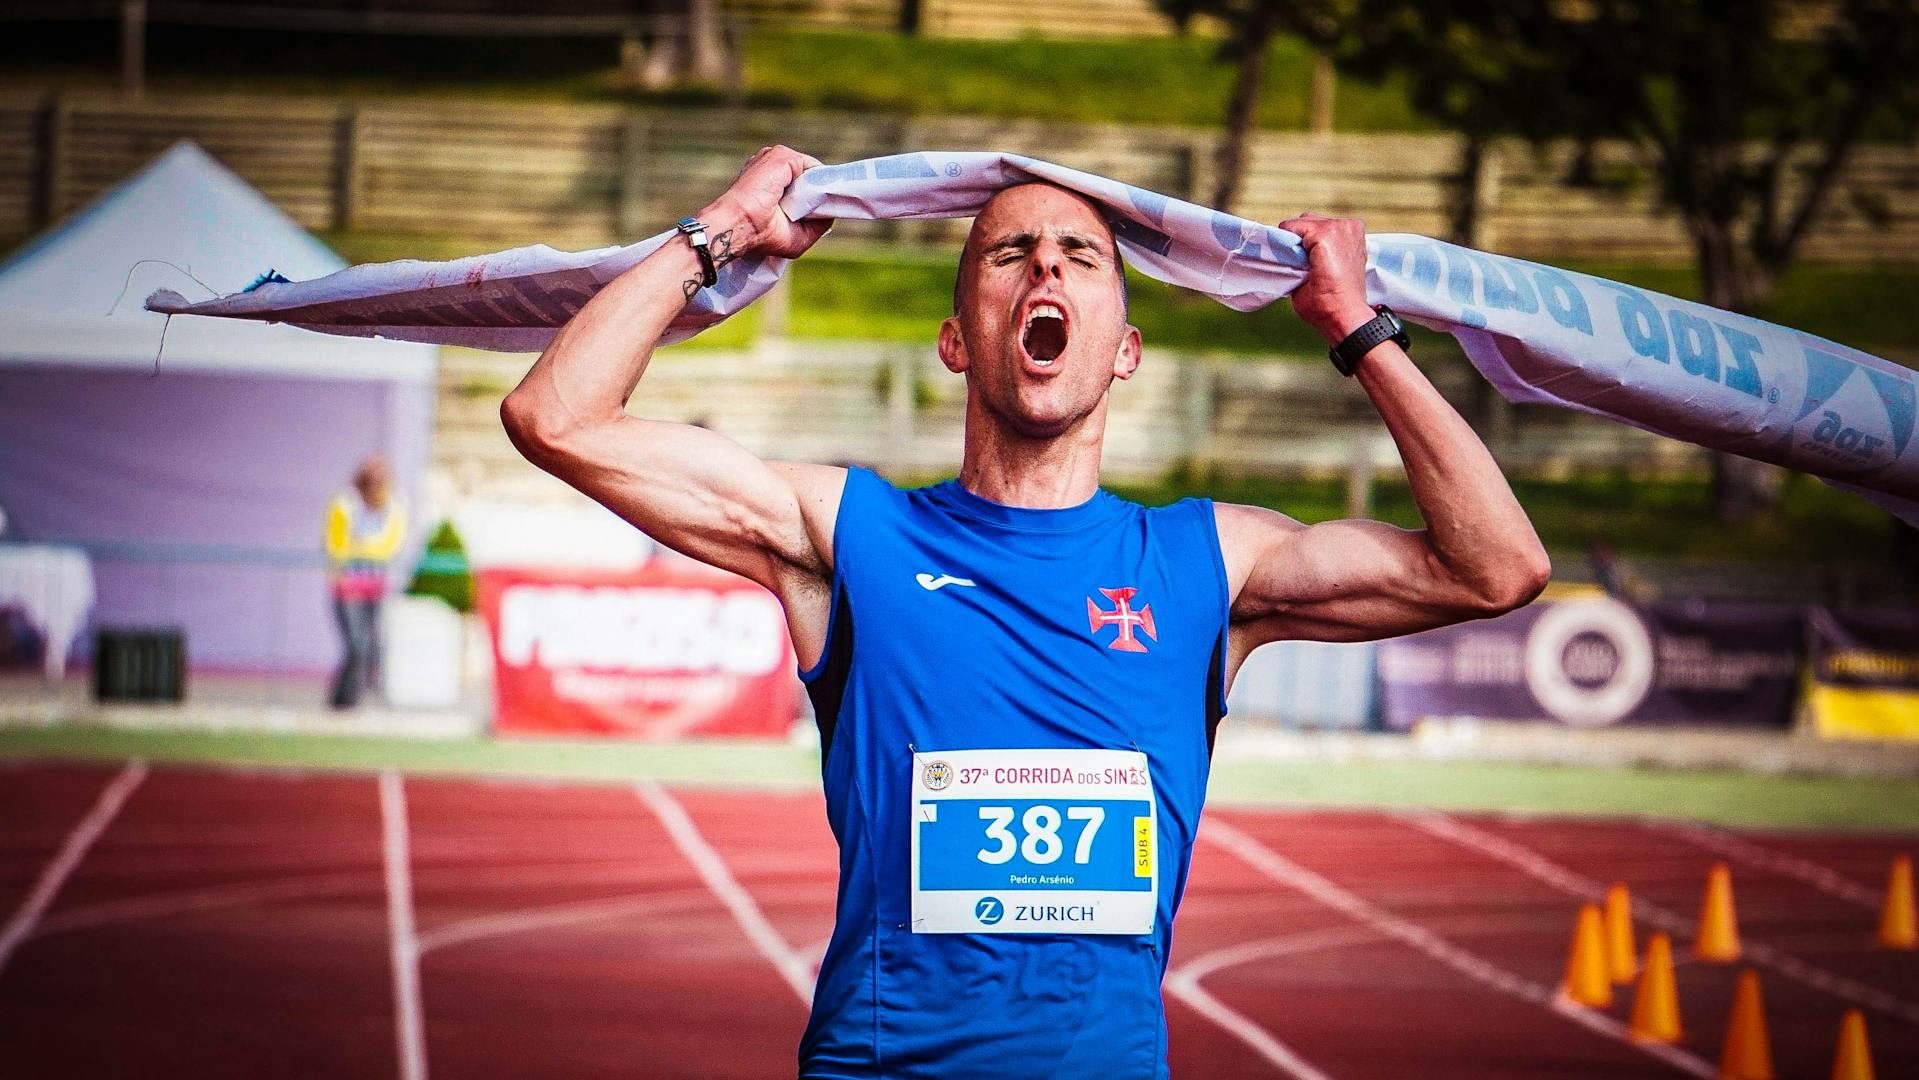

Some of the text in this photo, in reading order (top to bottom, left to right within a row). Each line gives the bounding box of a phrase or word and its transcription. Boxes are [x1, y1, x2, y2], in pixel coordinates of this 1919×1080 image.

[994, 767, 1074, 785] CORRIDA
[1077, 772, 1101, 785] DOS
[976, 805, 1106, 865] 387
[1138, 828, 1149, 867] SUB 4
[1010, 874, 1075, 885] Pedro Arsénio
[1015, 905, 1095, 922] ZURICH
